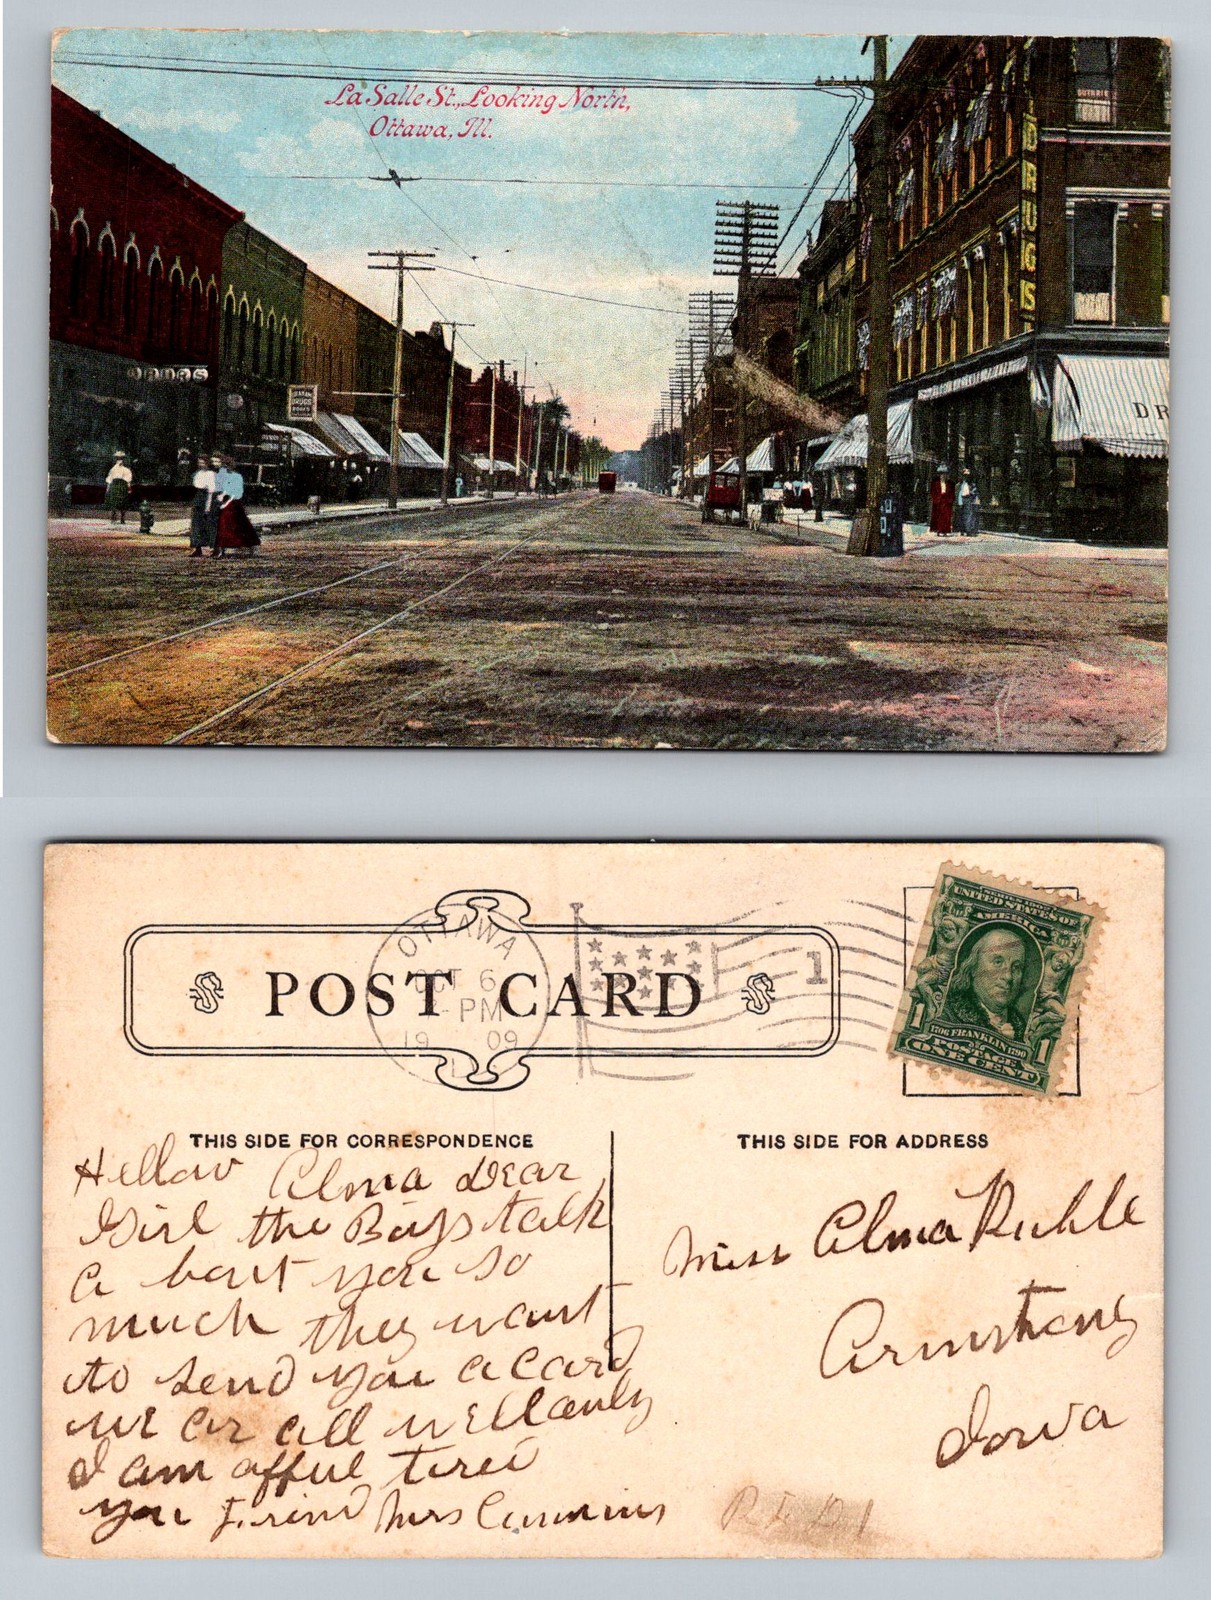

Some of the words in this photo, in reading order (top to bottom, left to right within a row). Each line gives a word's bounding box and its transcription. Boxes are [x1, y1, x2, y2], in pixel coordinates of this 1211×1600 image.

[365, 83, 425, 107] Salle
[461, 85, 556, 114] Looking
[558, 86, 631, 112] North,
[369, 115, 453, 141] Ottawa,
[457, 116, 493, 139] Ill.
[953, 886, 1004, 906] UNITED
[1004, 900, 1058, 921] STATES
[1058, 915, 1081, 927] OF
[397, 913, 517, 961] OTTAWA
[974, 912, 1049, 937] AMERICA
[265, 971, 455, 1018] POST
[499, 971, 702, 1018] CARD
[479, 969, 497, 992] 6
[460, 997, 503, 1023] PM
[909, 1003, 925, 1030] 1
[486, 1030, 519, 1051] 09
[933, 1038, 1017, 1067] POSTAGE
[951, 1027, 1008, 1050] FRANKLIN
[1034, 1038, 1051, 1066] 1
[912, 1041, 965, 1063] ONE
[968, 1057, 1036, 1083] CENT
[190, 1134, 237, 1148] THIS
[245, 1134, 291, 1148] SIDE
[300, 1134, 338, 1148] FOR
[347, 1134, 534, 1148] CORRESPONDENCE
[738, 1134, 785, 1149] THIS
[794, 1134, 839, 1149] SIDE
[848, 1134, 887, 1149] FOR
[896, 1134, 989, 1149] ADDRESS
[269, 1147, 432, 1203] Alma
[237, 1206, 331, 1249] the
[482, 1178, 610, 1233] talk
[813, 1190, 963, 1257] Alma
[455, 1245, 532, 1281] so
[68, 1296, 279, 1342] much
[62, 1356, 129, 1395] to
[155, 1354, 296, 1396] send
[118, 1454, 213, 1488] am
